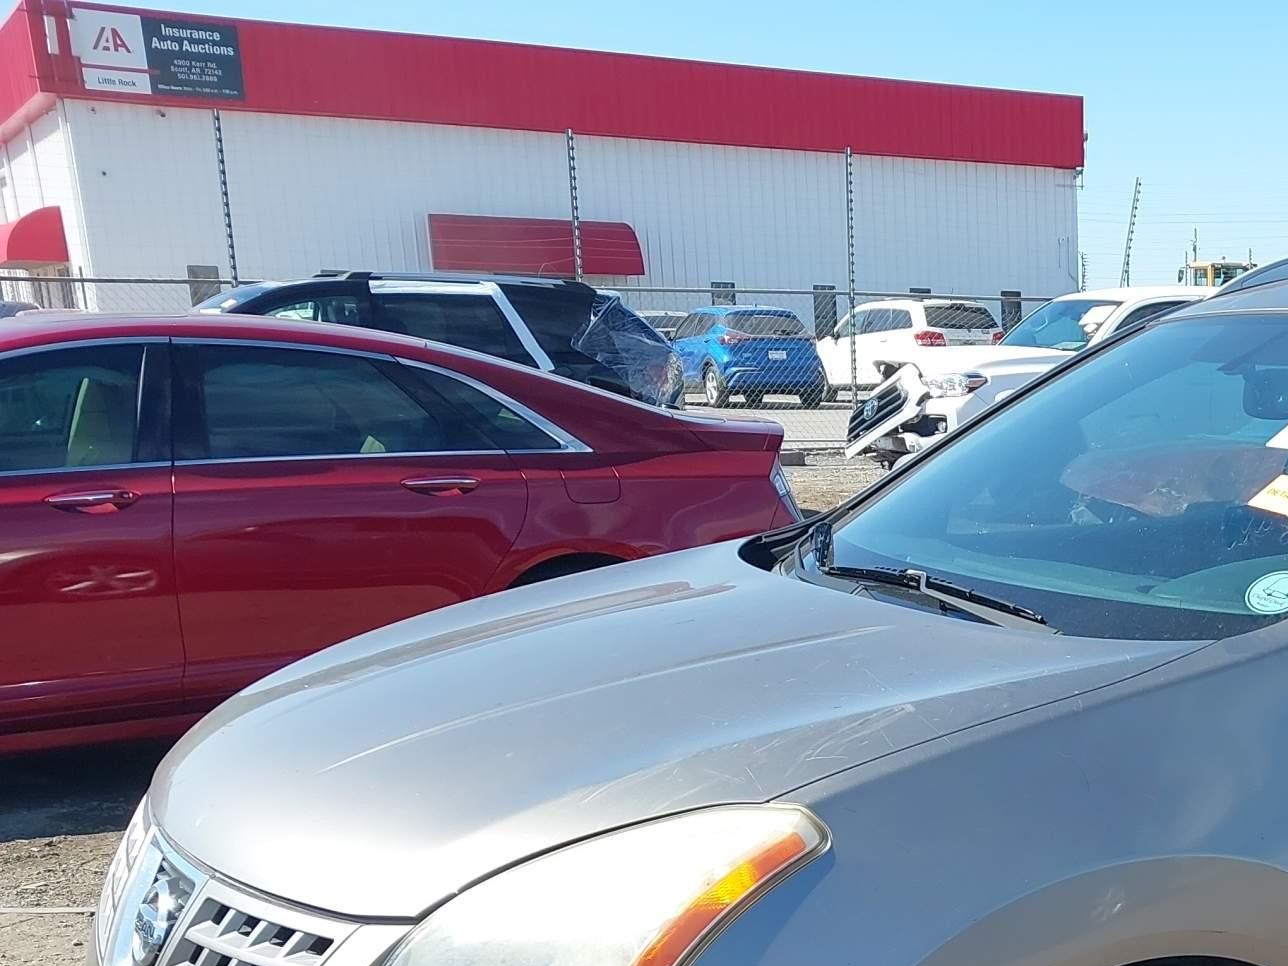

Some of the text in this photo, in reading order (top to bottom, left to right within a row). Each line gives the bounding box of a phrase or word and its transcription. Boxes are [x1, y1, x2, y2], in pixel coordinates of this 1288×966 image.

[161, 23, 221, 41] Insurance
[151, 37, 235, 56] Auto Auctions
[97, 76, 137, 88] Little Rock
